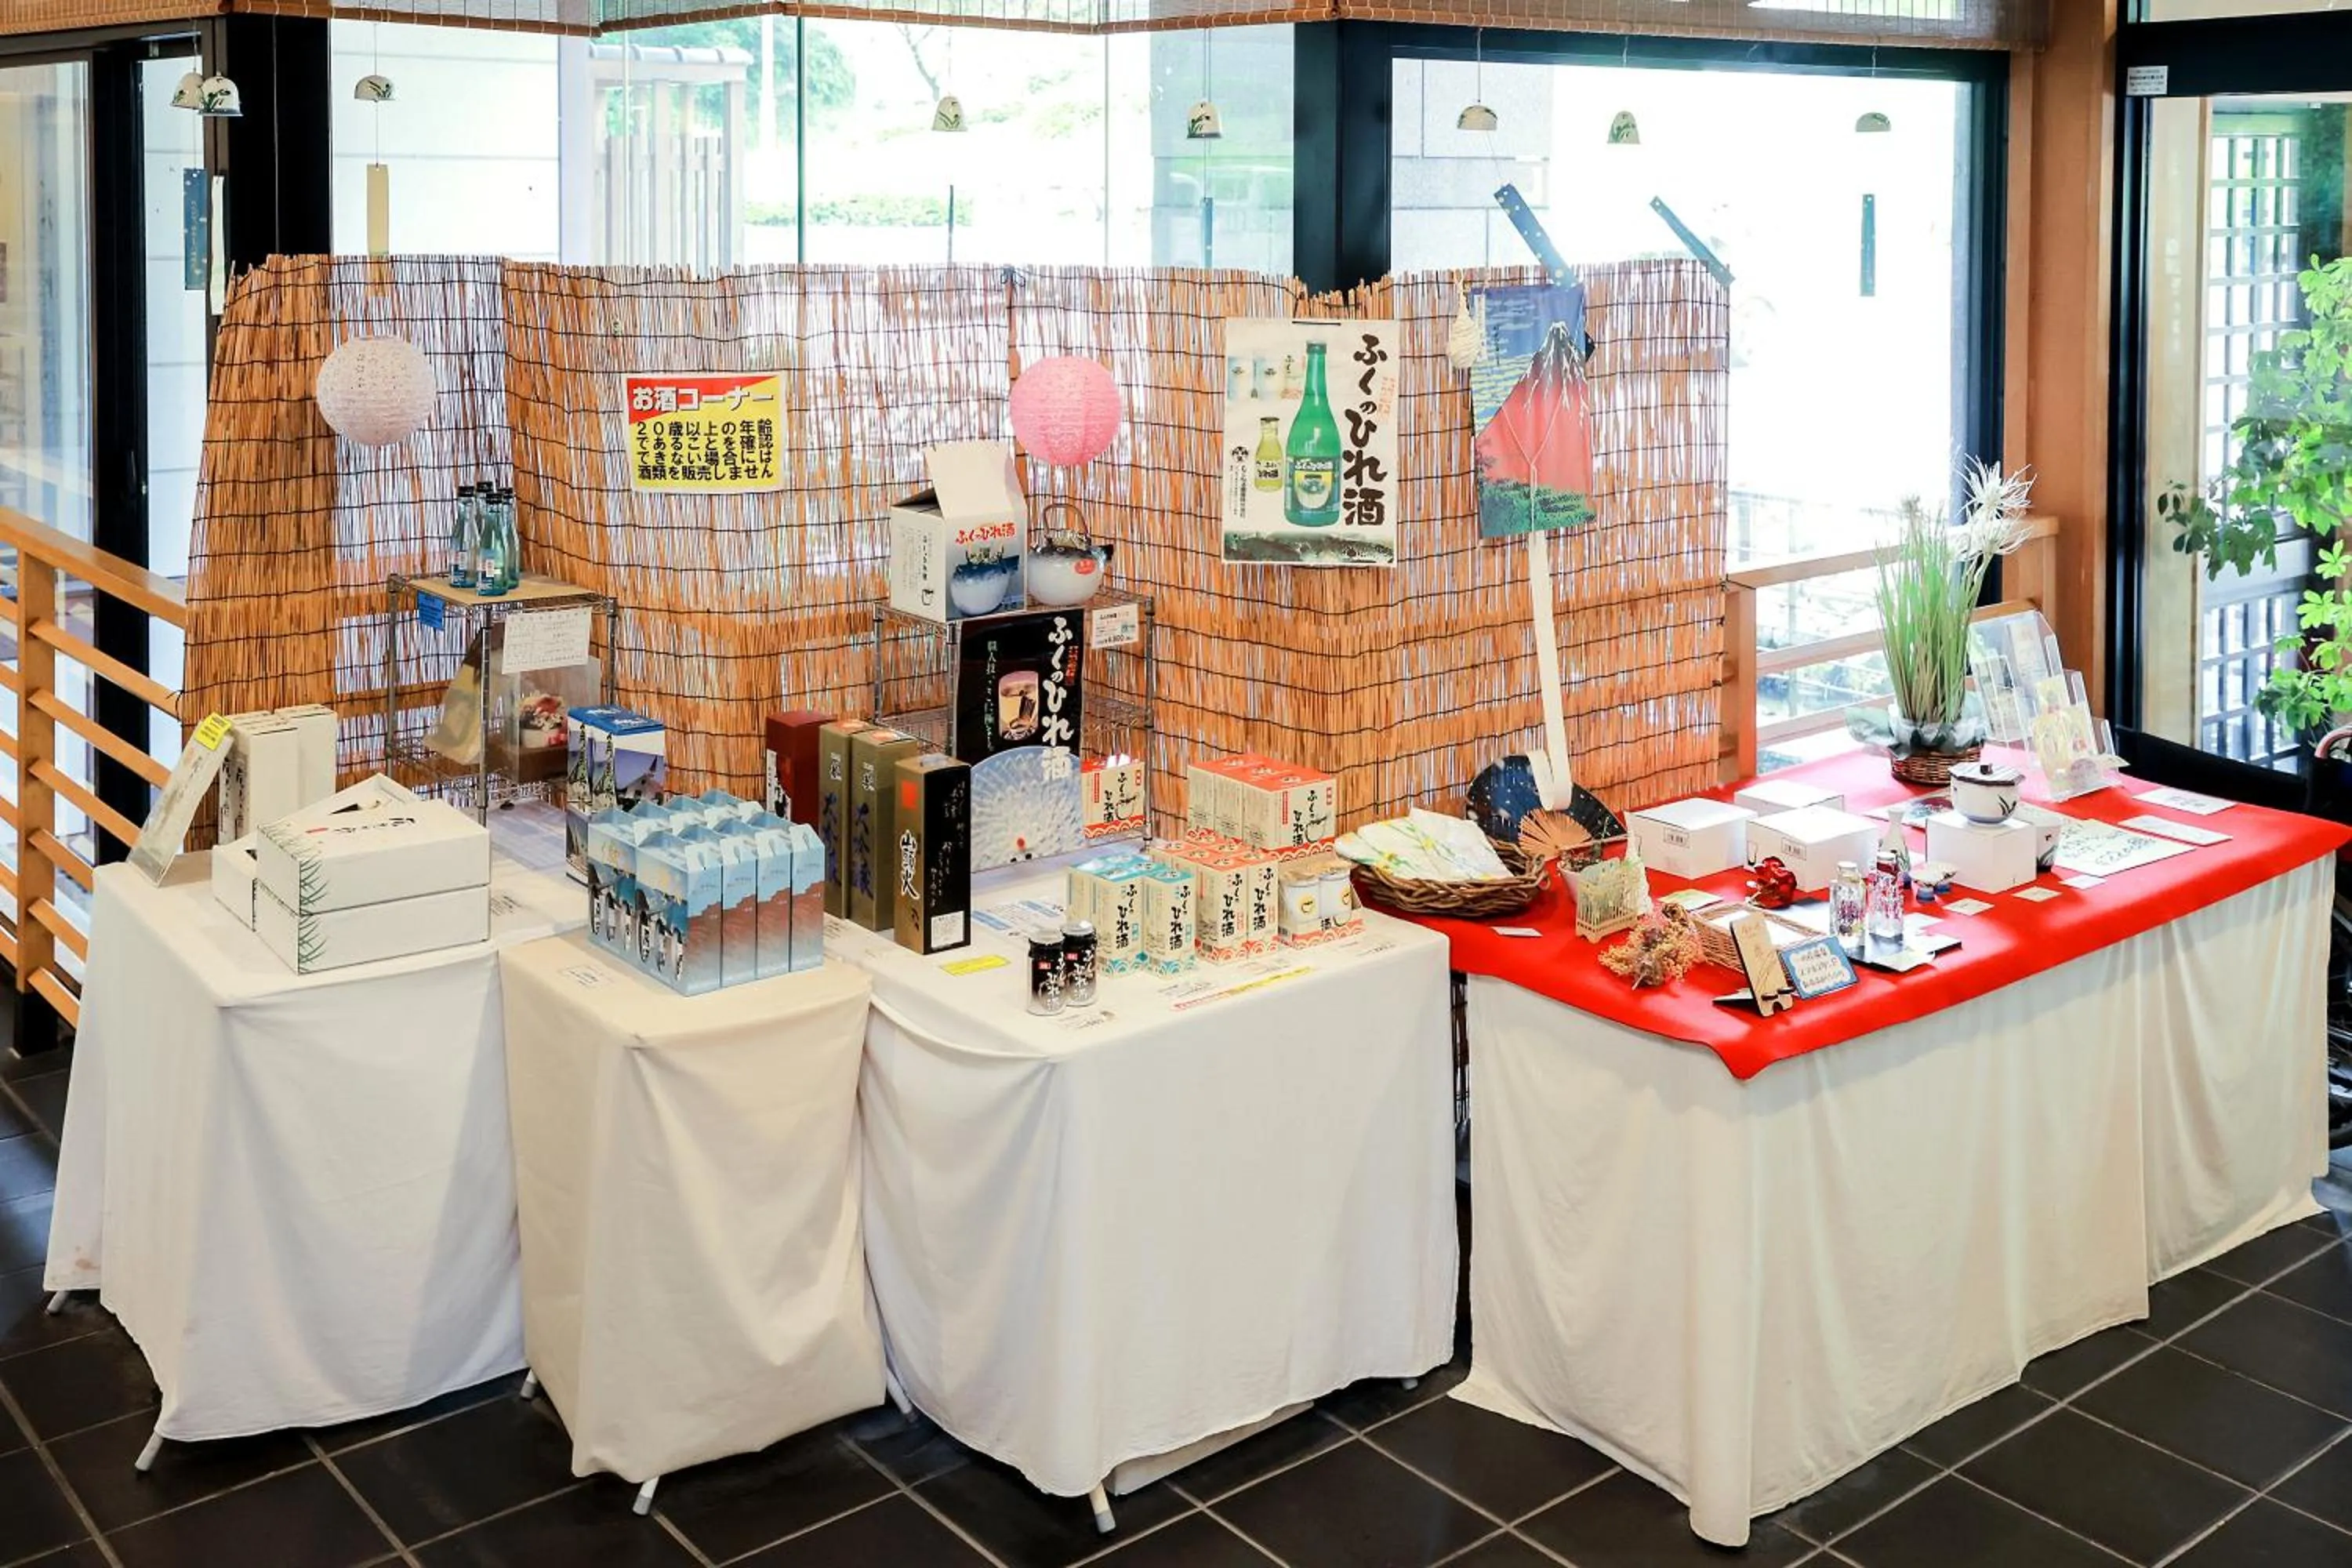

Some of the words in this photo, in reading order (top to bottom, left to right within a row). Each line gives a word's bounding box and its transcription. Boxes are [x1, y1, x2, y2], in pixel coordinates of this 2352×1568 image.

[633, 386, 774, 412] お酒コーナー
[637, 418, 773, 437] 20歳以上の年齢
[637, 436, 774, 450] であることを確認
[1341, 333, 1388, 525] ふくのひれ酒
[637, 450, 772, 466] できない場合には
[638, 464, 774, 481] 酒類を販売しません
[956, 522, 1015, 544] ふくのひれ酒
[1041, 616, 1074, 782] ふくのひれ酒
[1221, 895, 1235, 938] ひれ酒
[1254, 888, 1266, 931] ひれ酒
[1116, 905, 1130, 949] ひれ酒
[1169, 906, 1182, 950] ひれ酒
